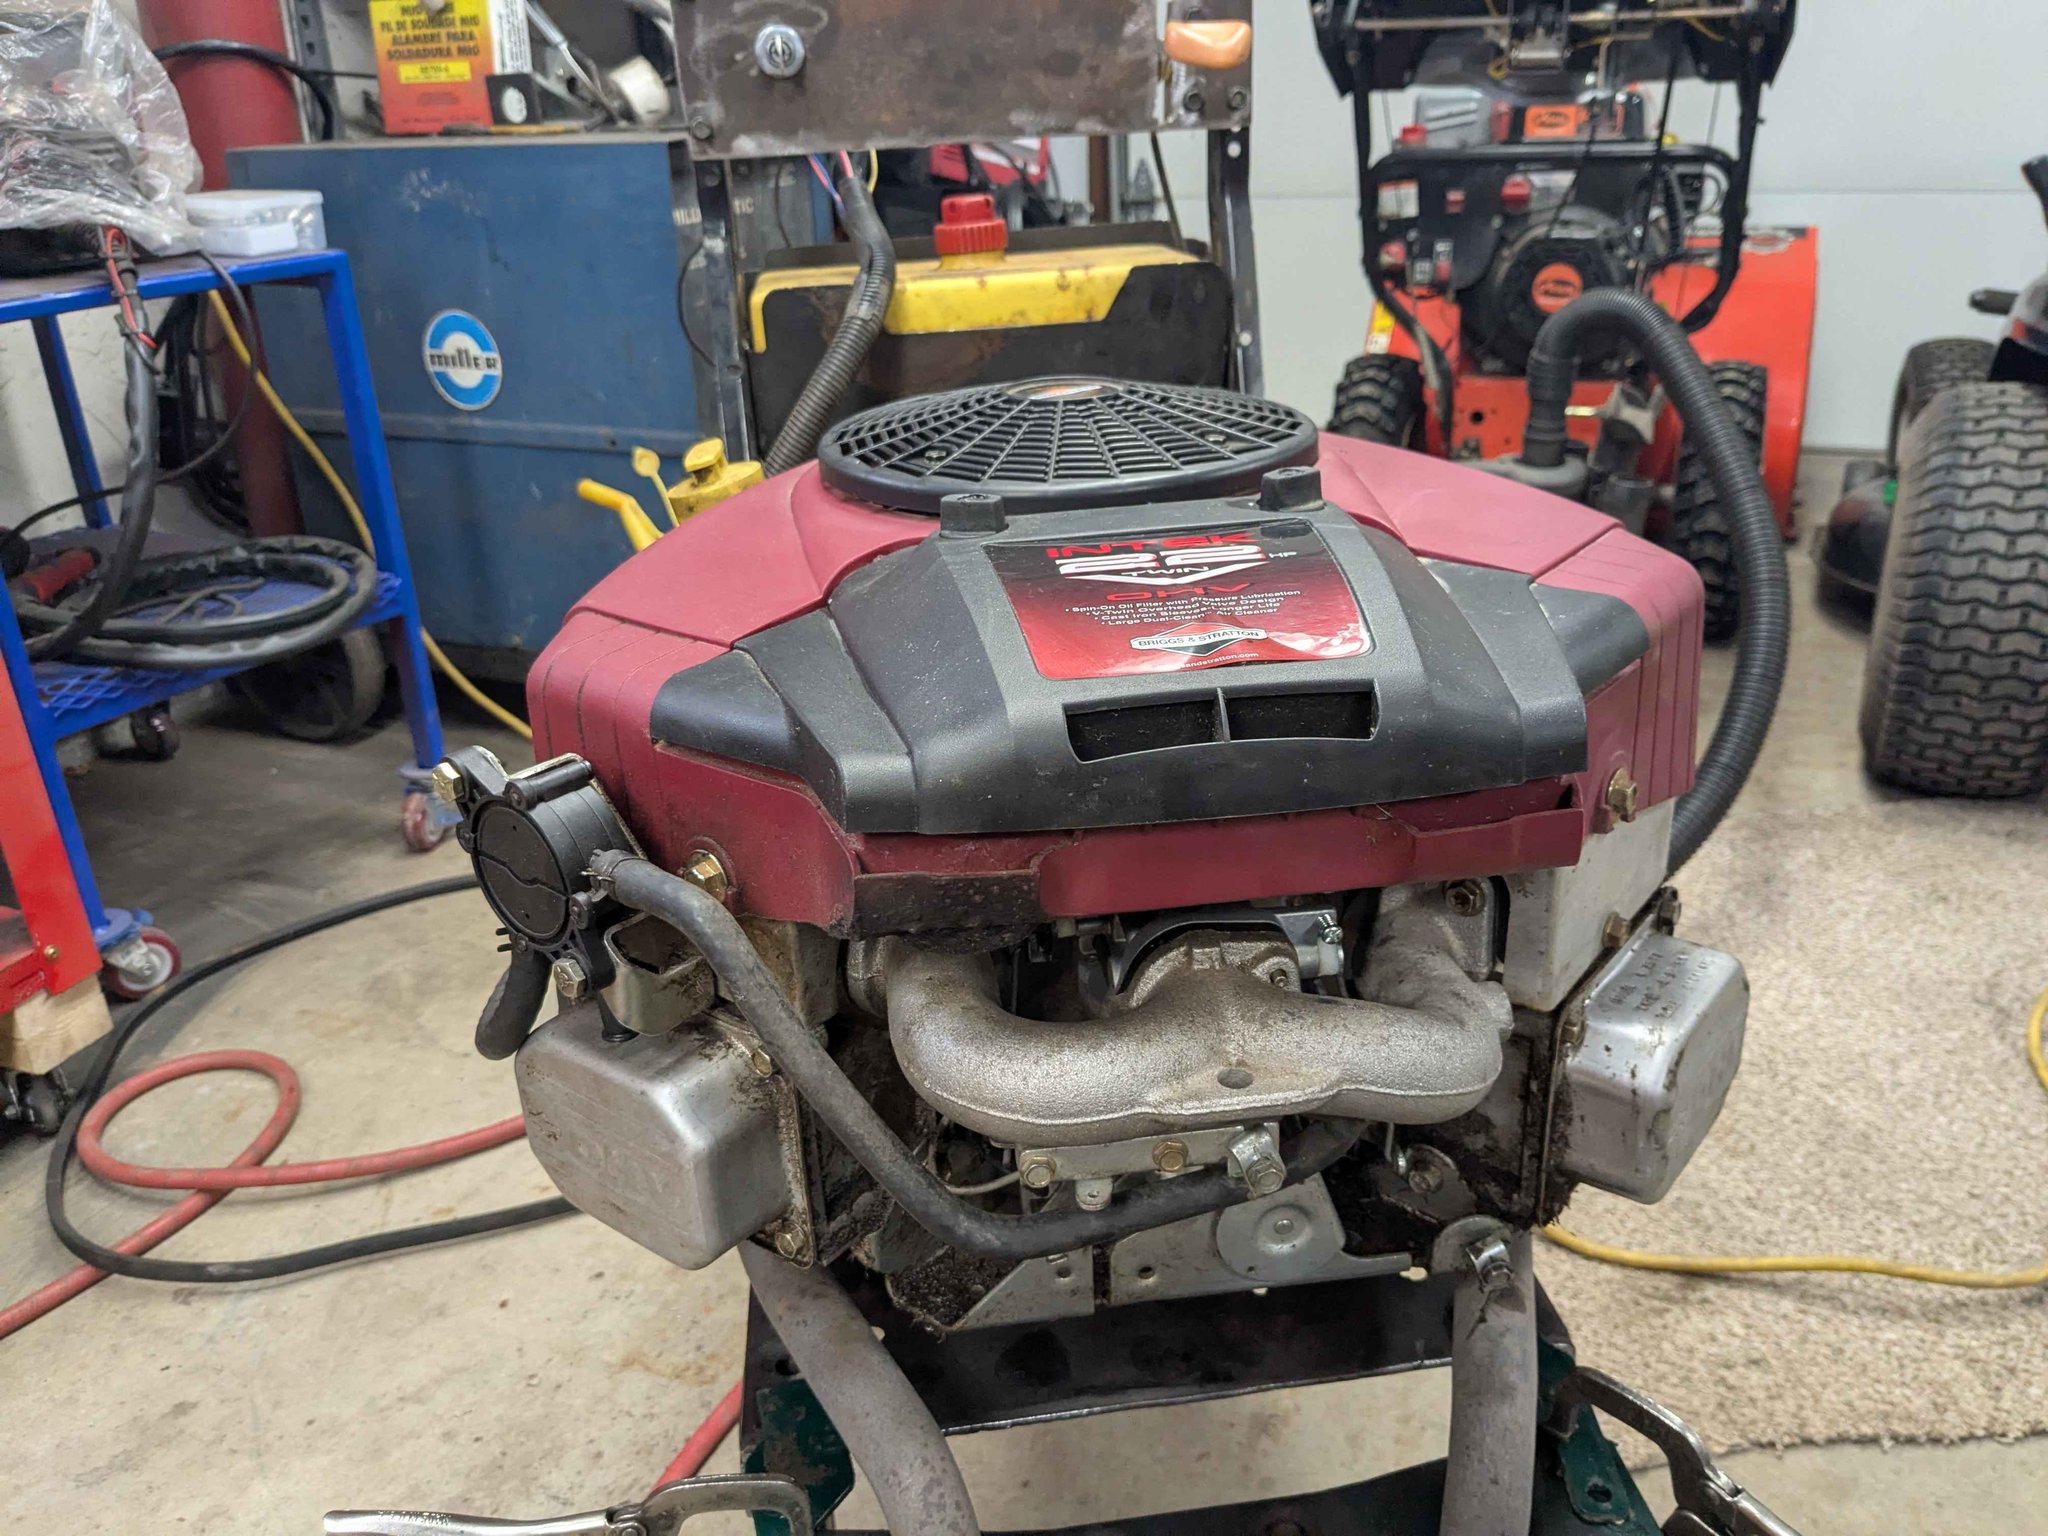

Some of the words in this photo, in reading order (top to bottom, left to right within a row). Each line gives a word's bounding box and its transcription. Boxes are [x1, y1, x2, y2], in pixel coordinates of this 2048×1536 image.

[1046, 532, 1259, 558] INTEK
[1055, 545, 1266, 575] 22
[1268, 551, 1298, 559] HP
[1121, 565, 1209, 577] TWIN
[1106, 583, 1250, 601] OHV
[1072, 604, 1115, 613] Spin-On
[1191, 595, 1238, 603] Pressure
[1240, 590, 1301, 600] Lubrication
[1138, 602, 1200, 613] Overhead
[1240, 597, 1285, 605] Design
[1235, 607, 1278, 616] Cleaner
[1138, 637, 1185, 647] BRIGGS
[1199, 630, 1259, 642] STRATTON
